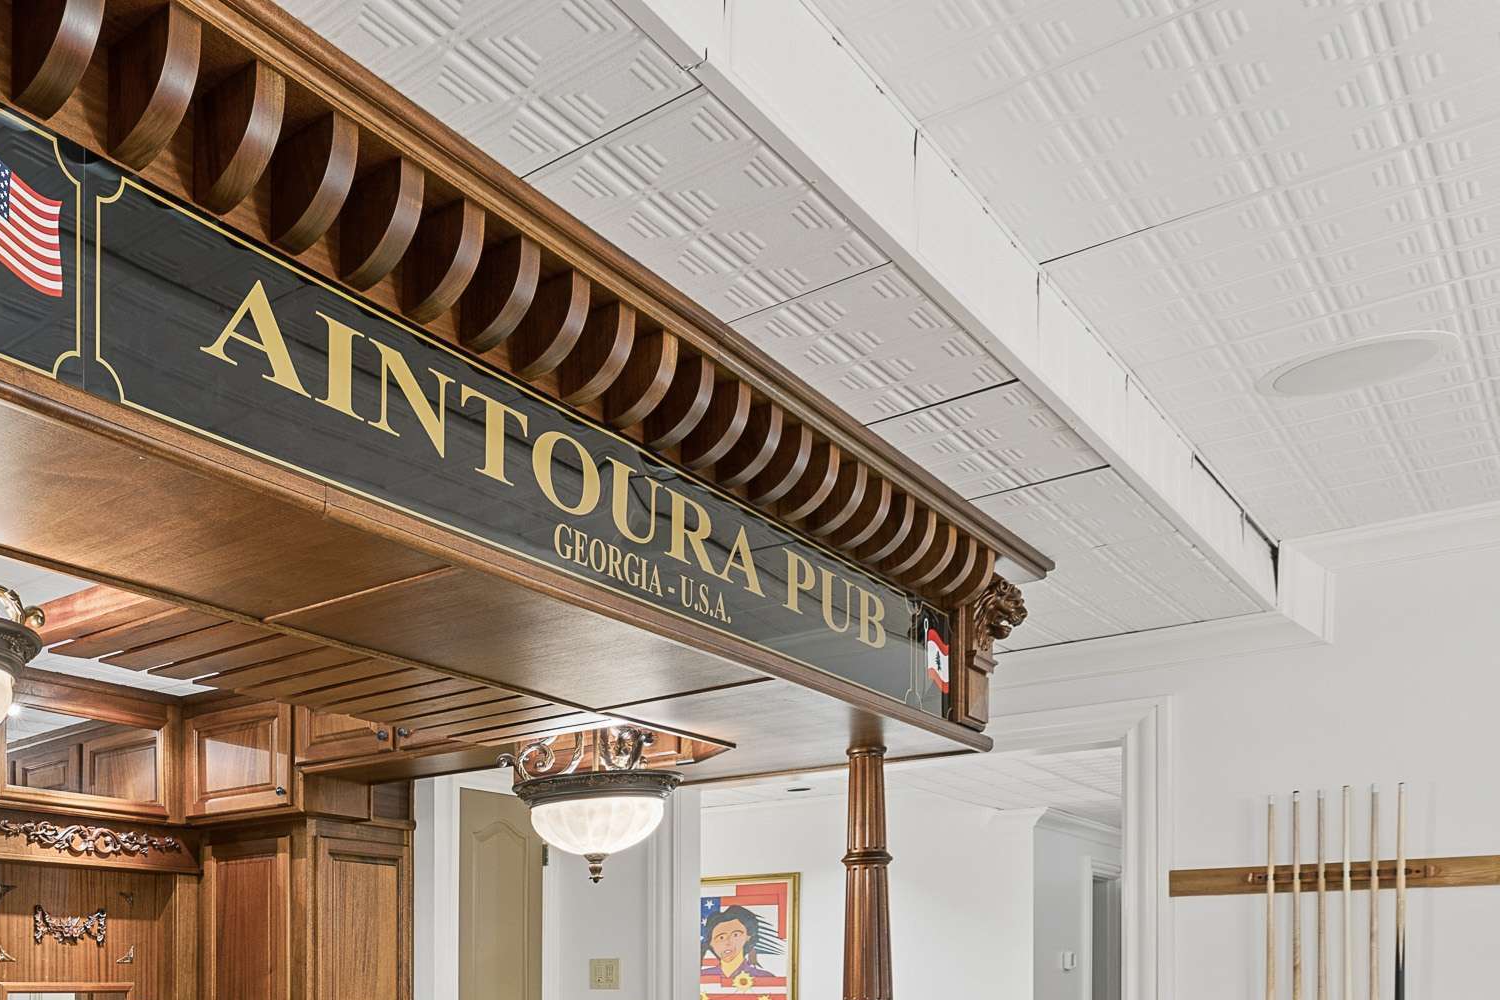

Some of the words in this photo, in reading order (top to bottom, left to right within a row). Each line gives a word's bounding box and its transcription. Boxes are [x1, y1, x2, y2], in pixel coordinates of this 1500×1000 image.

[199, 279, 767, 598] AINTOURA
[781, 547, 887, 649] PUB
[553, 522, 664, 598] GEORGIA
[678, 574, 732, 625] U.S.A.
